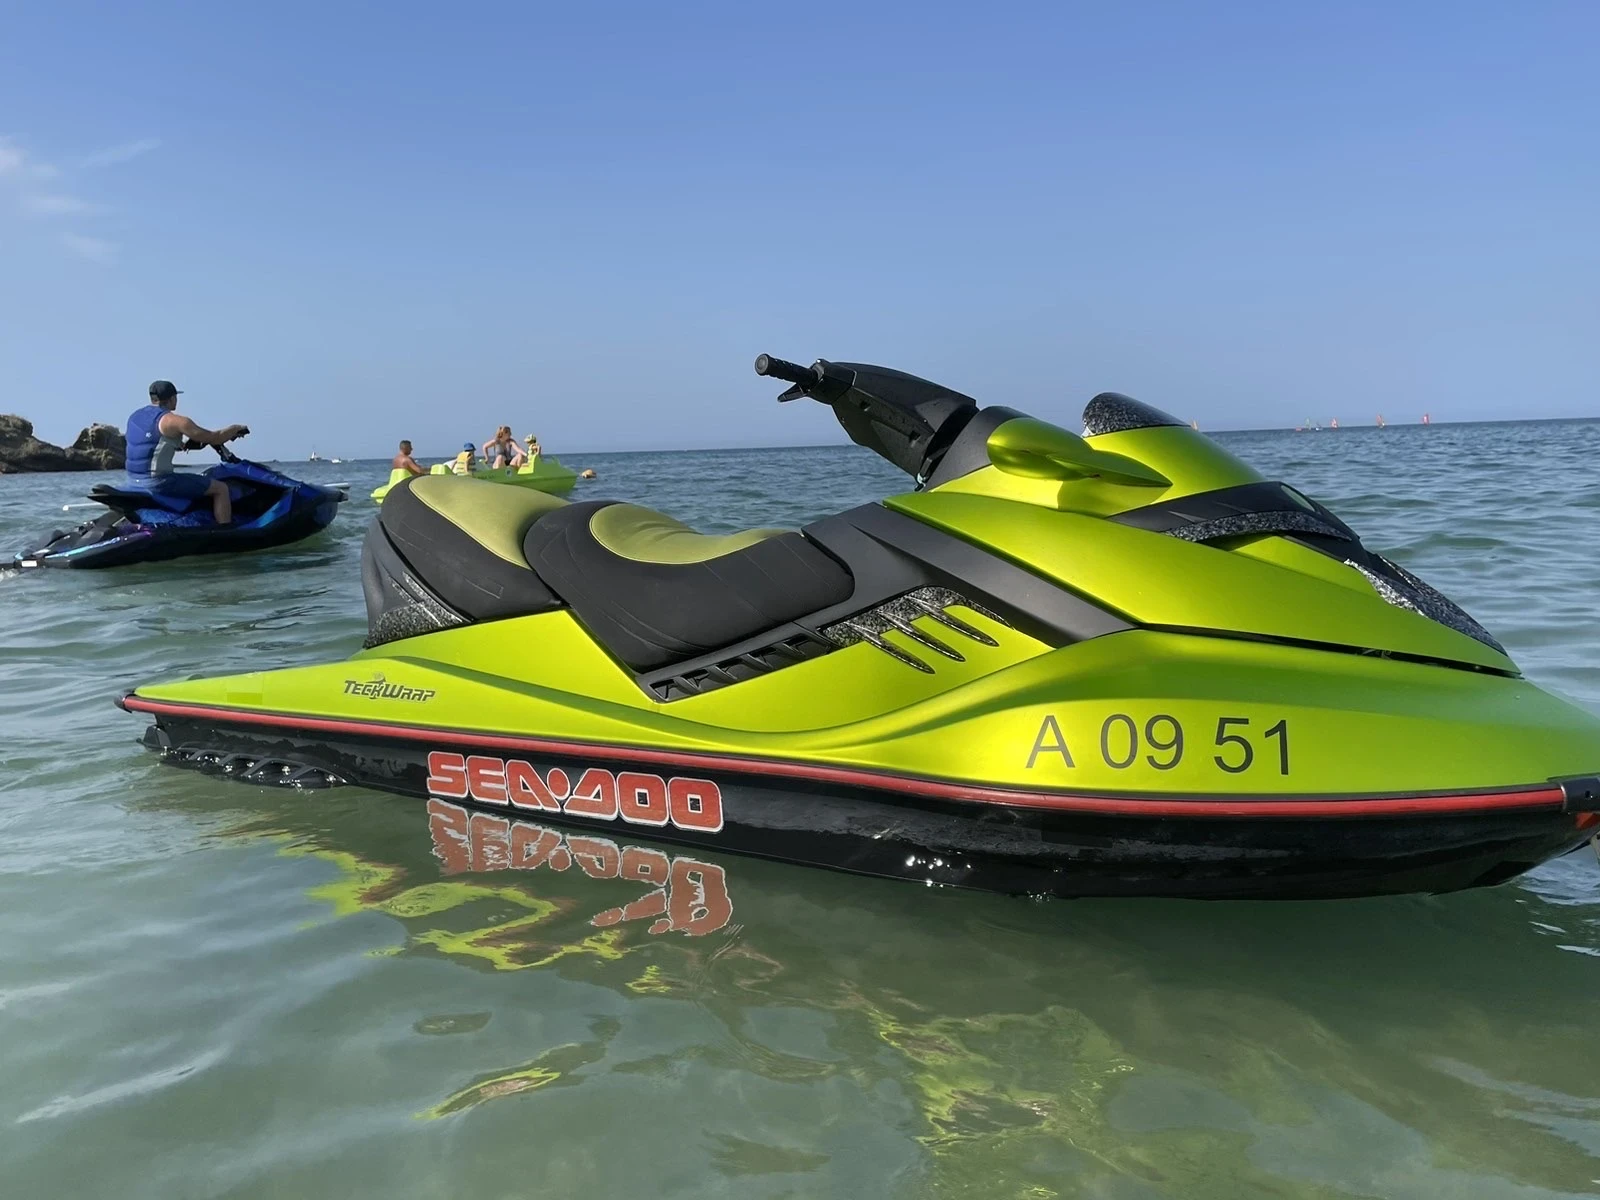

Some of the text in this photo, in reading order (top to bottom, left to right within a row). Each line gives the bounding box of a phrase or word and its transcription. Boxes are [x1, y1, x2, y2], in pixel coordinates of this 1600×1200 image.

[1025, 713, 1290, 776] A 09 51
